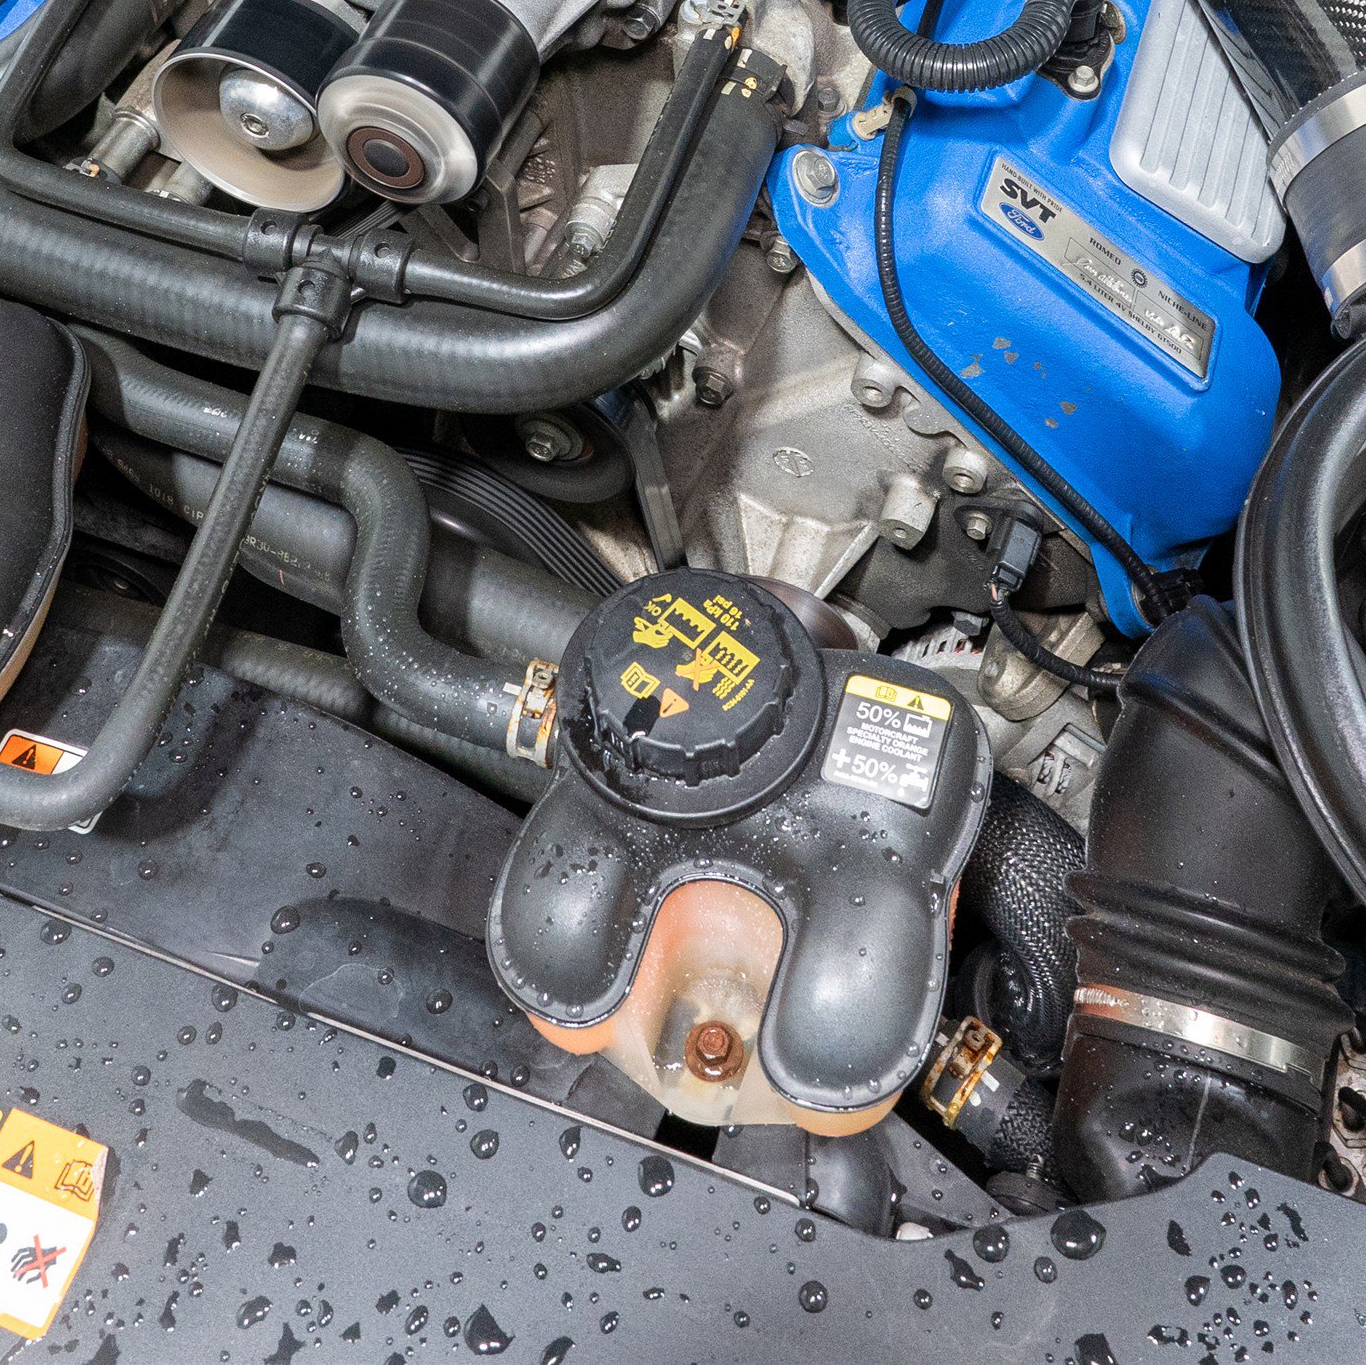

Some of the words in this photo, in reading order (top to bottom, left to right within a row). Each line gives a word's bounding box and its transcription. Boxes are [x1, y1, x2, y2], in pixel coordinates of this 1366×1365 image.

[999, 178, 1057, 223] SVT
[1034, 187, 1047, 201] WITH
[1047, 198, 1063, 213] PRIDE
[1007, 209, 1036, 234] Ford
[1079, 273, 1092, 286] 5.4
[1093, 284, 1115, 305] LITER
[1115, 301, 1127, 313] 4V
[1128, 310, 1156, 334] SHELBY
[1157, 333, 1182, 354] GT500
[644, 601, 662, 616] OK
[713, 595, 732, 610] psi
[720, 614, 740, 630] 110
[856, 701, 901, 728] 50%
[847, 726, 892, 747] SPECIALTY
[892, 737, 928, 756] ORANGE
[861, 722, 918, 743] MOTORCRAFT
[849, 735, 881, 751] ENGINE
[881, 744, 923, 762] COOLANT
